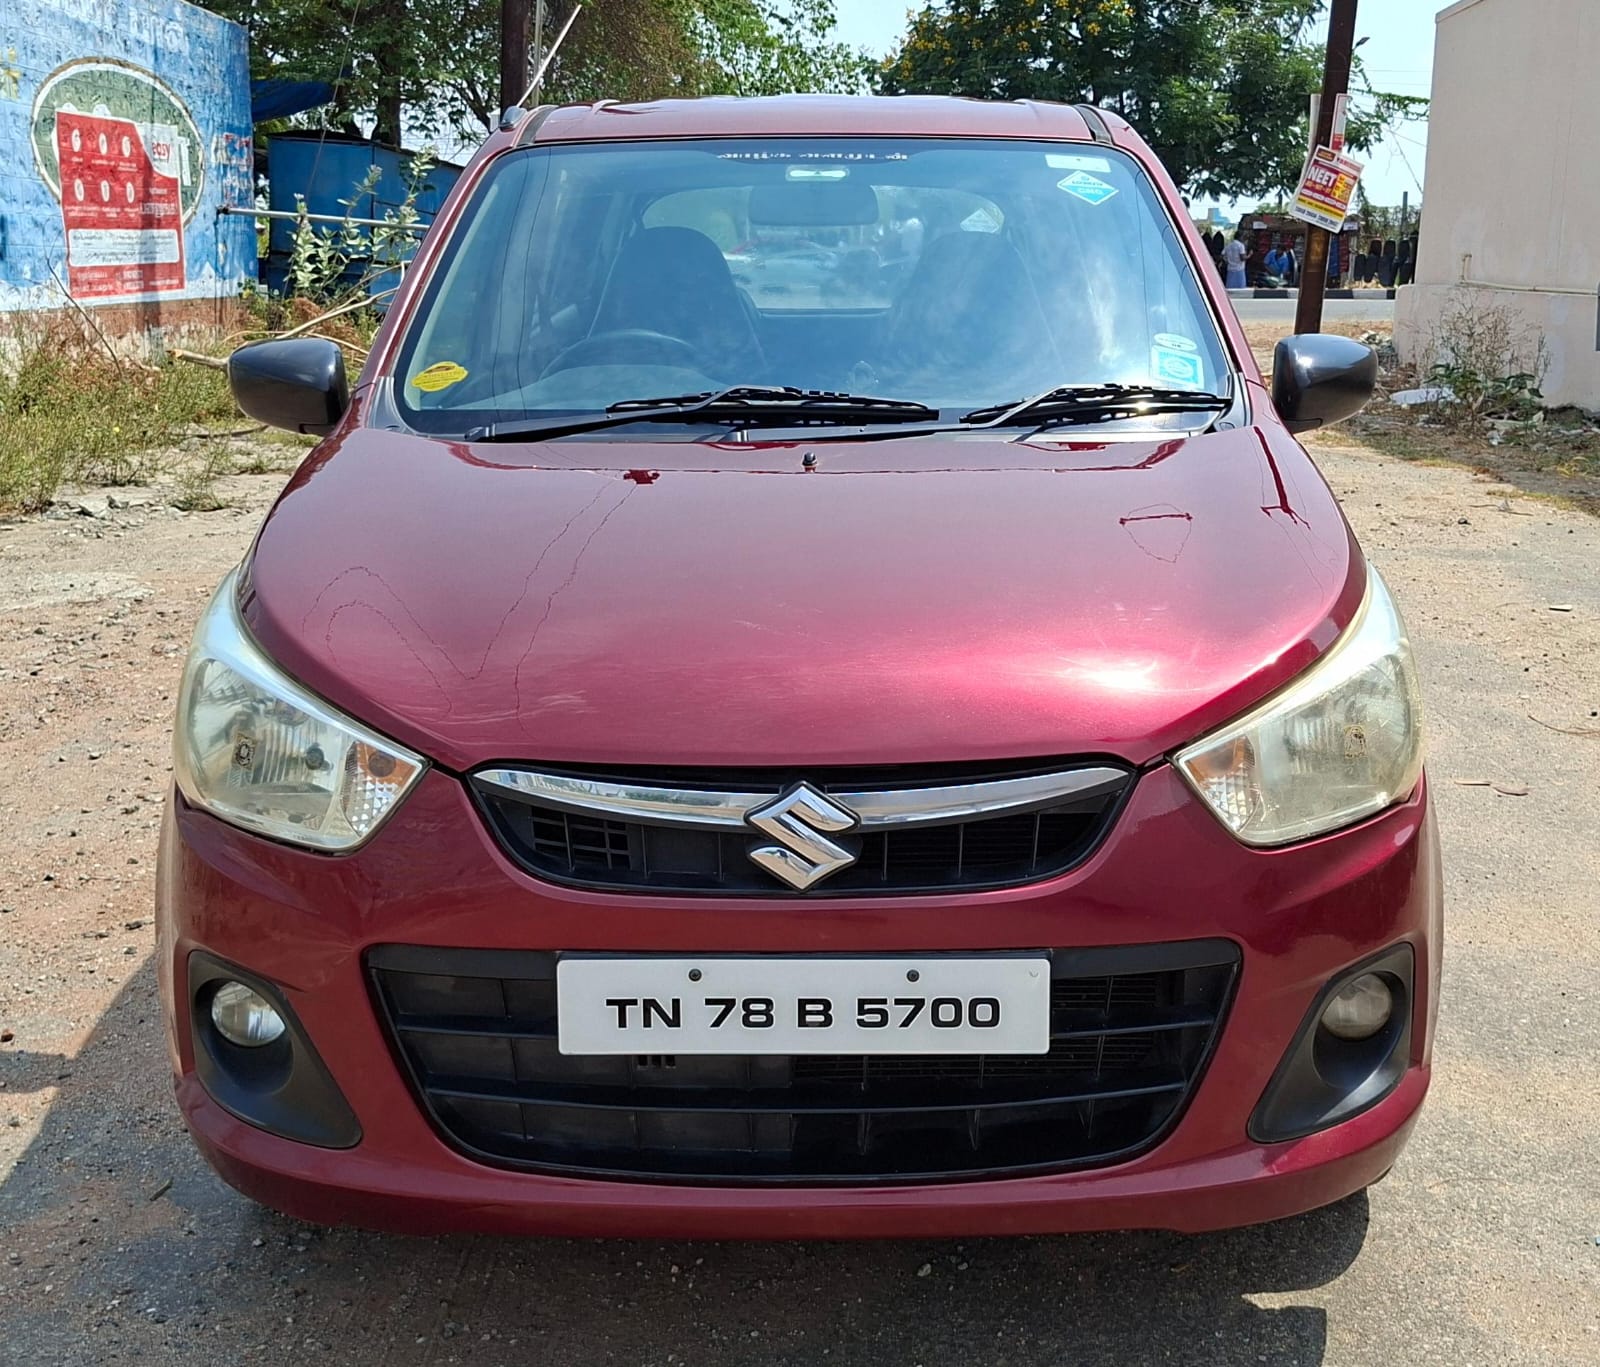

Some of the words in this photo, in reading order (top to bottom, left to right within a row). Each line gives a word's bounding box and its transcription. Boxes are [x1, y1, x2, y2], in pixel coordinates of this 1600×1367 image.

[1308, 166, 1337, 188] NEET
[605, 998, 682, 1029] TN
[704, 998, 775, 1029] 78
[797, 998, 834, 1029] B
[856, 998, 1001, 1029] 5700
